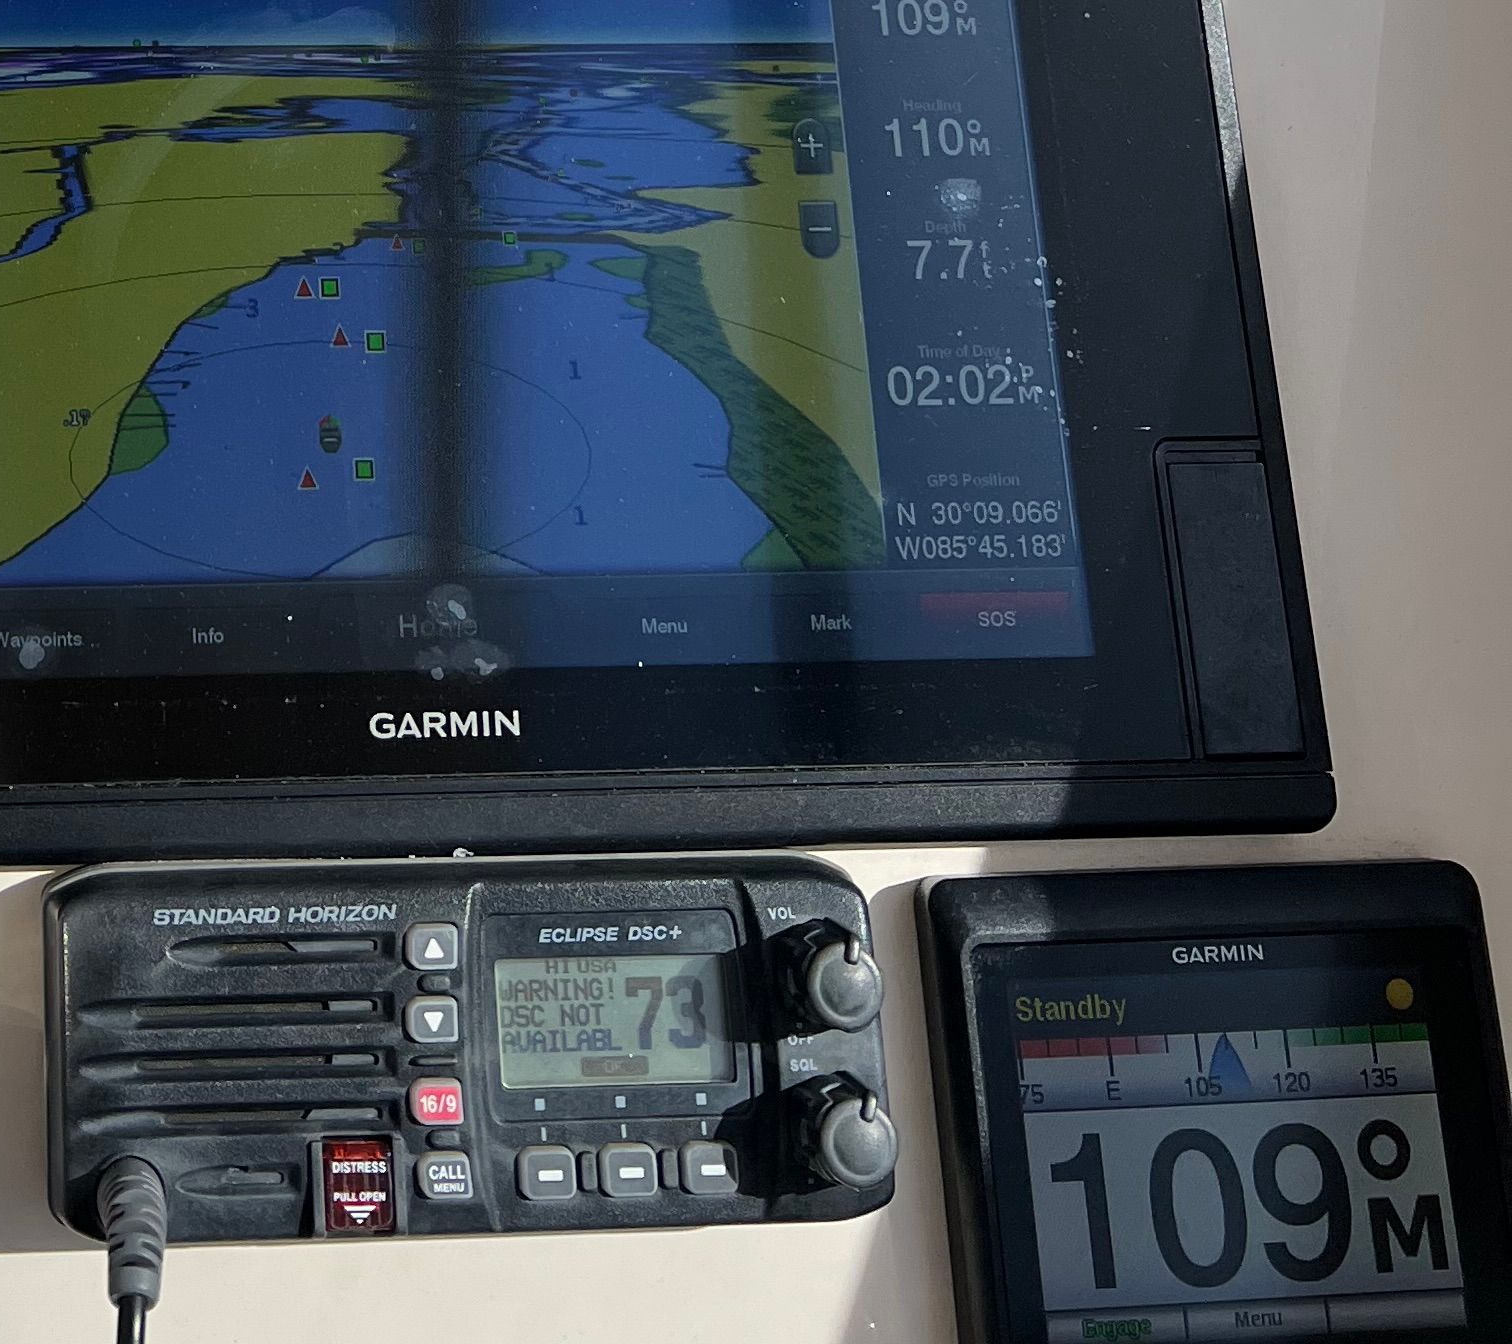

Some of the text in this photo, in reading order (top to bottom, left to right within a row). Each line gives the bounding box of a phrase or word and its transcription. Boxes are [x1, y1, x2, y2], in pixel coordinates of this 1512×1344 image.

[906, 240, 974, 280] 7.7
[918, 344, 1001, 362] Time of Day
[888, 364, 1015, 406] 02:02
[926, 473, 1021, 487] GPS Position
[896, 502, 916, 526] N
[642, 617, 688, 634] Menu
[811, 614, 852, 632] Mark
[978, 611, 1016, 628] SOS
[192, 628, 224, 645] Info
[369, 710, 521, 740] GARMIN
[153, 904, 398, 926] STANDARD HORIZON
[768, 908, 796, 920] VOL
[538, 925, 682, 944] ECLIPSE DSC+
[1171, 944, 1265, 965] GARMIN
[578, 960, 617, 974] USA
[499, 977, 615, 1002] WARNING!
[501, 1004, 604, 1028] DSC NOT
[625, 976, 706, 1050] 73
[1015, 994, 1127, 1026] Standby
[502, 1028, 623, 1054] AVAILABL
[790, 1058, 818, 1072] SQL
[1106, 1080, 1122, 1102] E
[1184, 1076, 1223, 1098] 105
[1272, 1072, 1311, 1094] 120
[1358, 1066, 1398, 1090] 135
[420, 1094, 456, 1113] 16/9
[332, 1160, 387, 1174] DISTRESS
[428, 1164, 466, 1180] CALL
[334, 1191, 386, 1202] PULL OPEN
[433, 1182, 465, 1194] MENU
[1367, 1194, 1450, 1275] M
[1234, 1308, 1284, 1329] Menu
[1081, 1316, 1152, 1342] Engage
